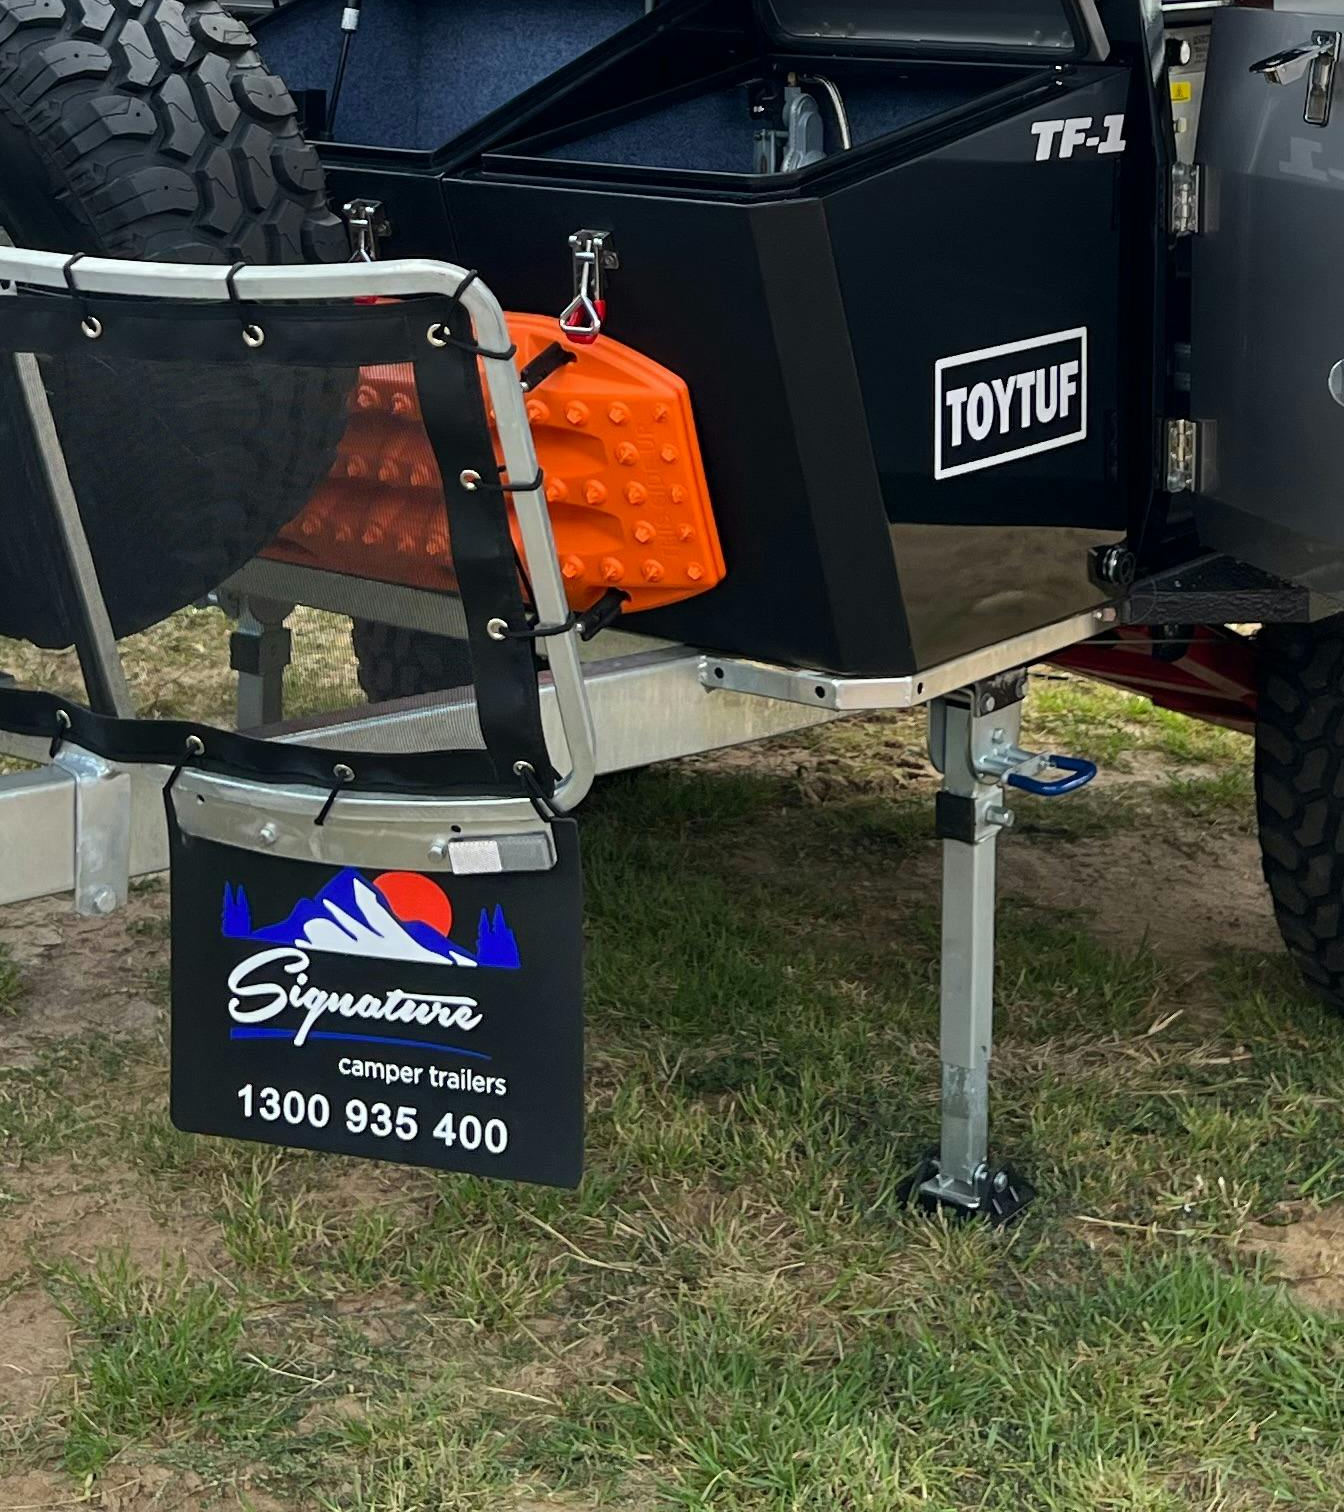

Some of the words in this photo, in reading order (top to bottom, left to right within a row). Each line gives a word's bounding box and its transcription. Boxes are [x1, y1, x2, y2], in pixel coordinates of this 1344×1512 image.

[1030, 113, 1127, 161] TF-1
[945, 359, 1080, 447] TOYTUF
[228, 946, 484, 1047] Signature
[337, 1056, 424, 1087] camper
[428, 1063, 508, 1096] trailers
[237, 1083, 331, 1129] 1300
[344, 1099, 419, 1141] 935
[432, 1112, 509, 1155] 400
